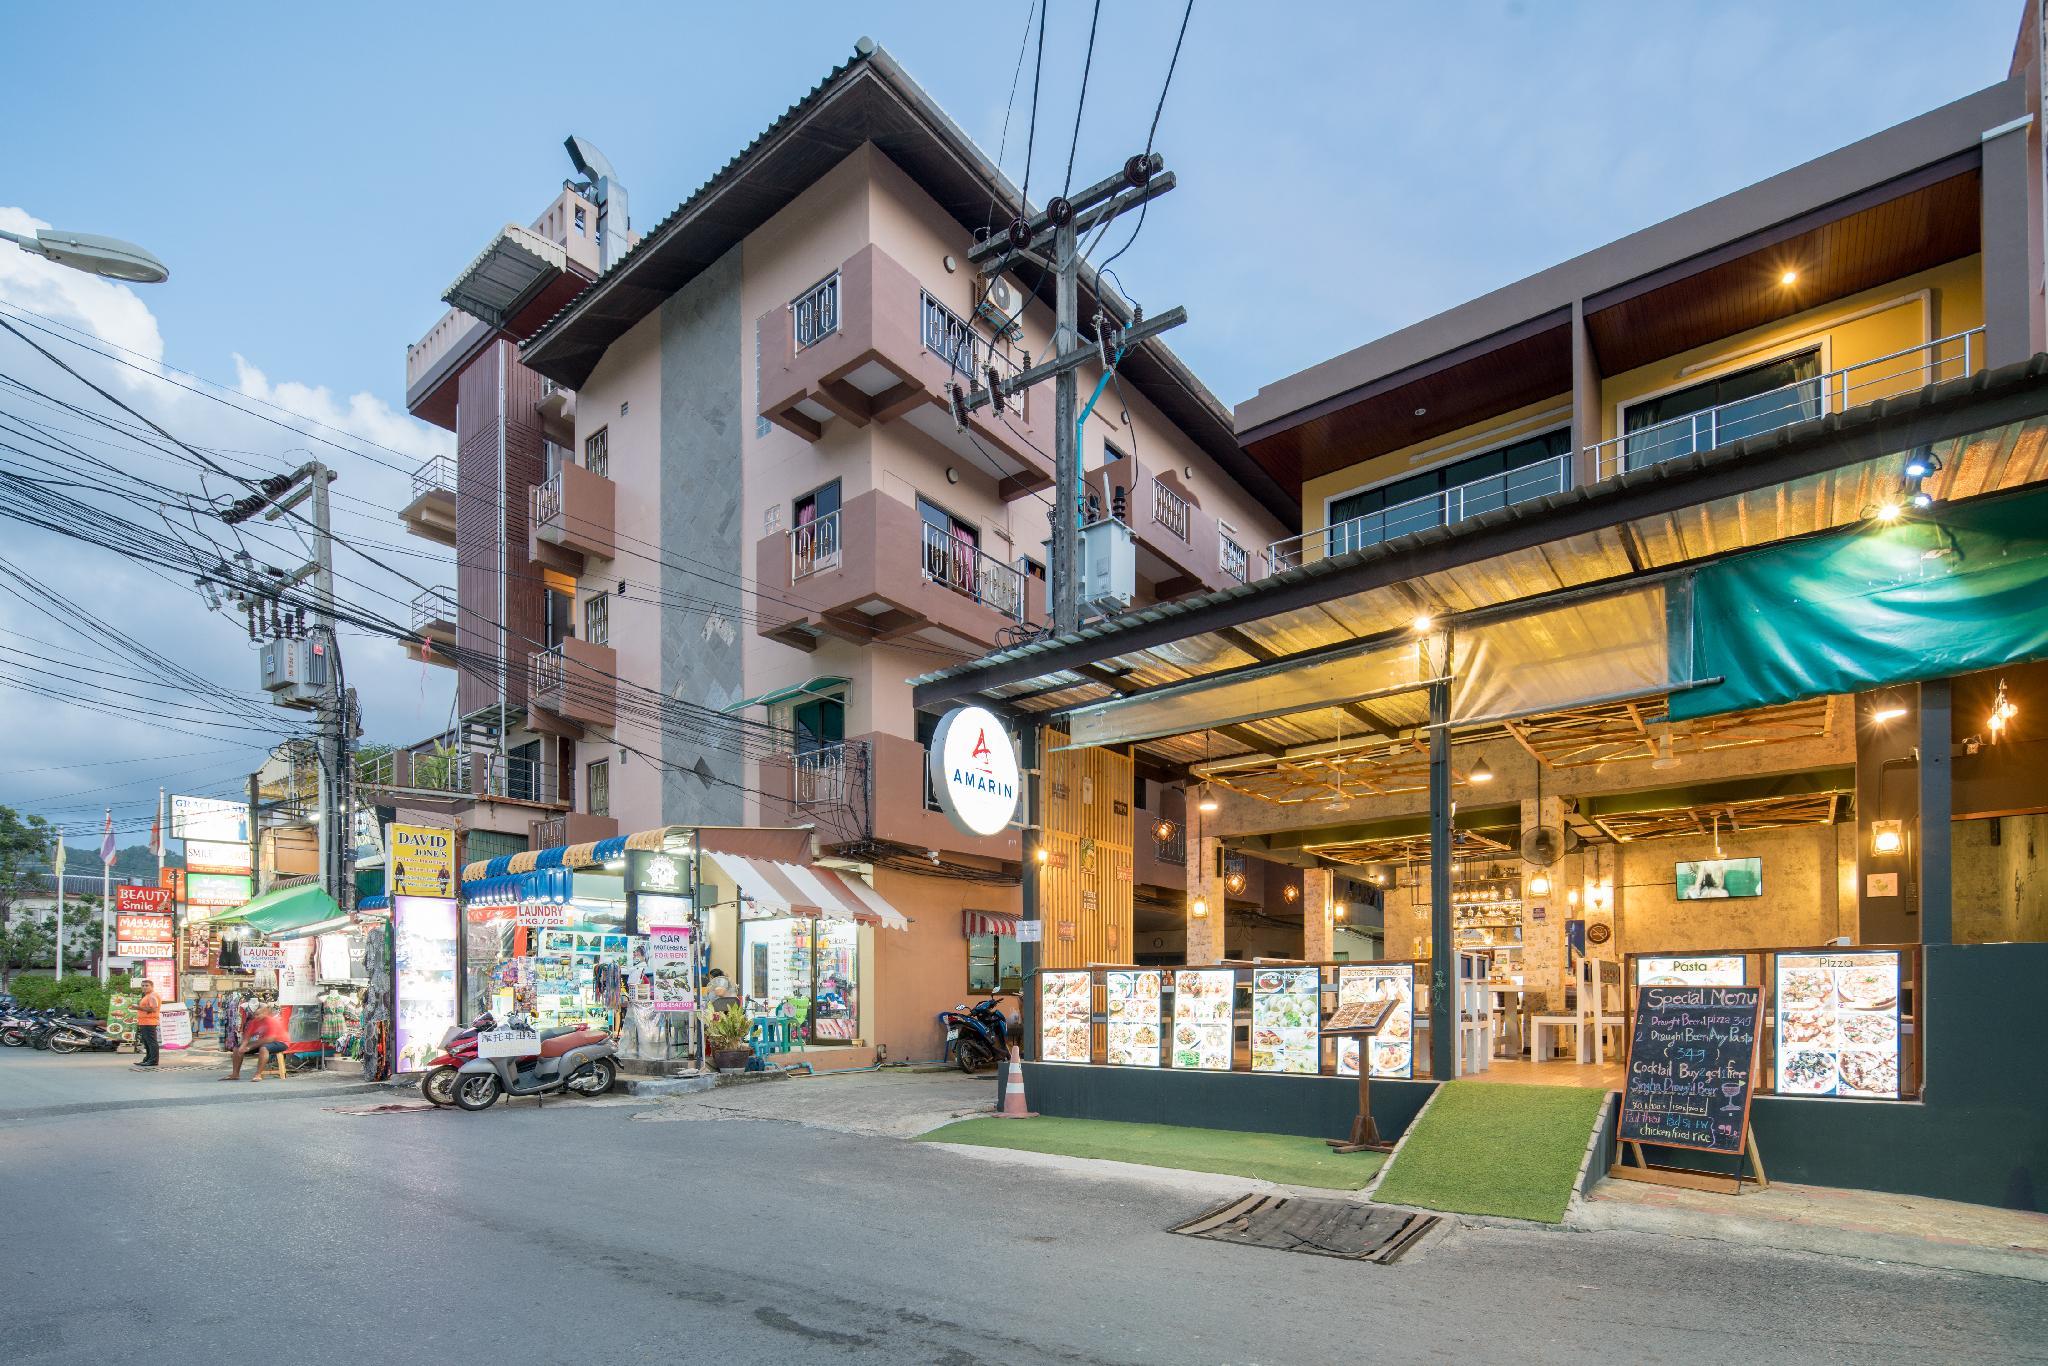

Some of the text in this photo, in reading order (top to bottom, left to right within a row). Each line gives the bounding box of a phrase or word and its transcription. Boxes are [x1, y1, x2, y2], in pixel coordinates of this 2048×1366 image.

[953, 769, 1012, 799] AMARIN
[398, 832, 447, 848] DAVID
[119, 888, 170, 902] BEAUTY
[122, 900, 154, 911] Smile
[518, 905, 563, 917] LAUNDRY
[119, 917, 170, 929] MASSAGE
[660, 935, 680, 943] CAR
[119, 944, 170, 955] LAUNDRY
[243, 949, 286, 957] LAUNDRY
[1673, 961, 1708, 972] Pasta
[1819, 957, 1854, 968] Pizza
[1647, 988, 1758, 1014] Special Menu
[1651, 1016, 1680, 1031] Draught
[1732, 1016, 1753, 1027] 349
[1651, 1030, 1683, 1047] Draught
[1729, 1026, 1754, 1044] Pasta
[1633, 1060, 1672, 1077] Cocktail
[1679, 1062, 1699, 1082] Buy
[1726, 1060, 1747, 1079] free
[1697, 1081, 1718, 1094] Beer
[1640, 1123, 1711, 1143] chicken fried rice
[1718, 1124, 1732, 1136] 99
